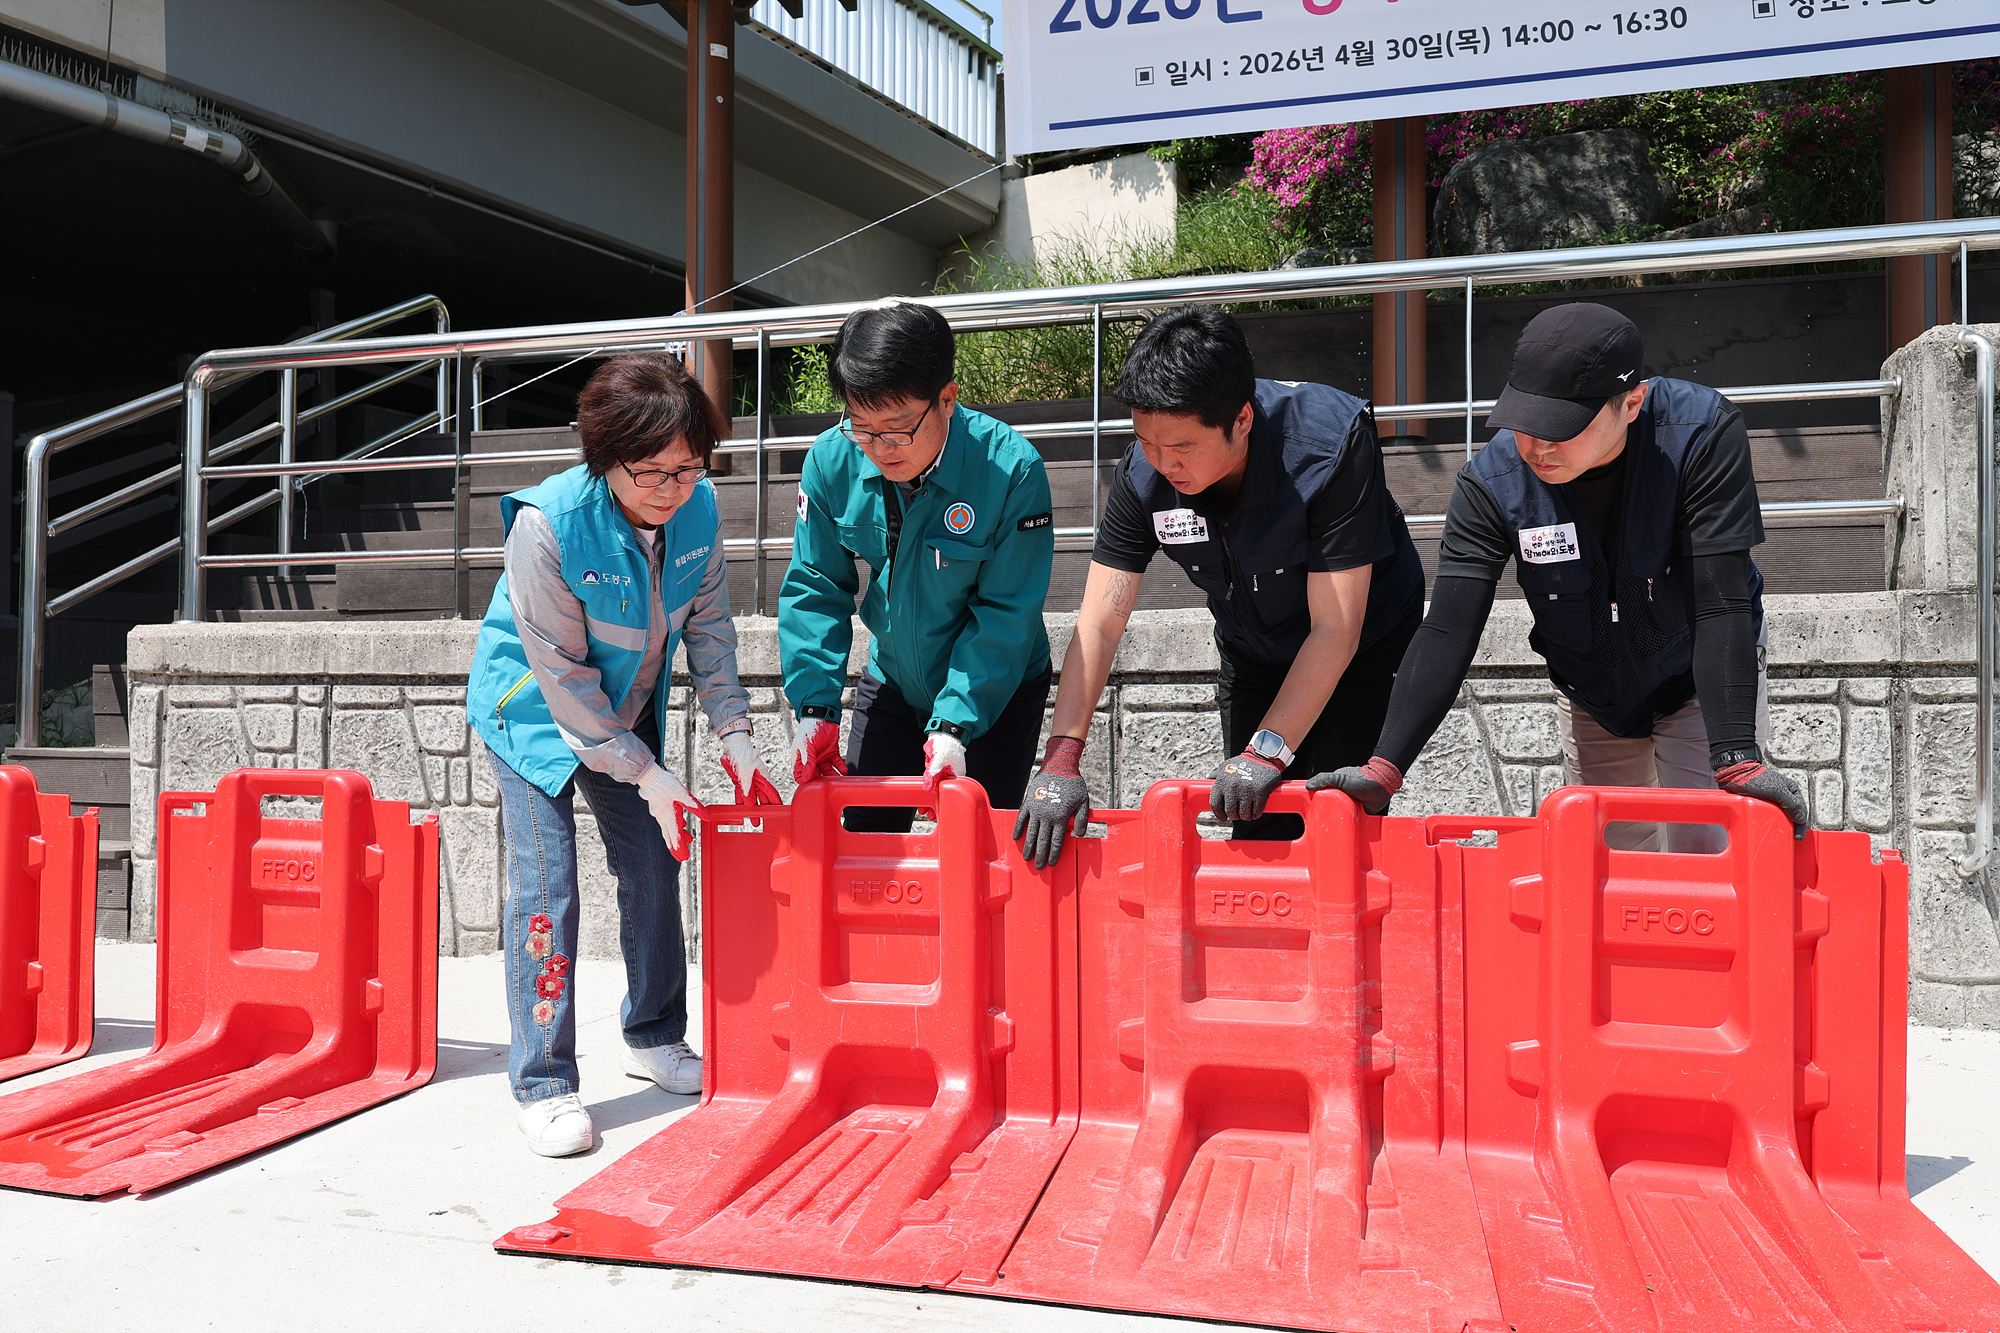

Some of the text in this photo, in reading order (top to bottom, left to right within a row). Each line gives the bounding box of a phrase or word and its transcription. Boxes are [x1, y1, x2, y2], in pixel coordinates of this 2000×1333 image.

[1165, 58, 1212, 86] 일시
[1240, 46, 1325, 76] 2026년
[1335, 40, 1375, 67] 4월
[1386, 26, 1491, 60] 30일(목)
[1502, 19, 1574, 48] 14:00
[1612, 6, 1687, 36] 16:30
[1531, 531, 1565, 542] dobong
[602, 573, 632, 587] 도봉구
[262, 858, 315, 882] FFOC
[850, 880, 923, 905] FFOC
[1210, 890, 1291, 917] FFOC
[1621, 905, 1715, 936] FFOC
